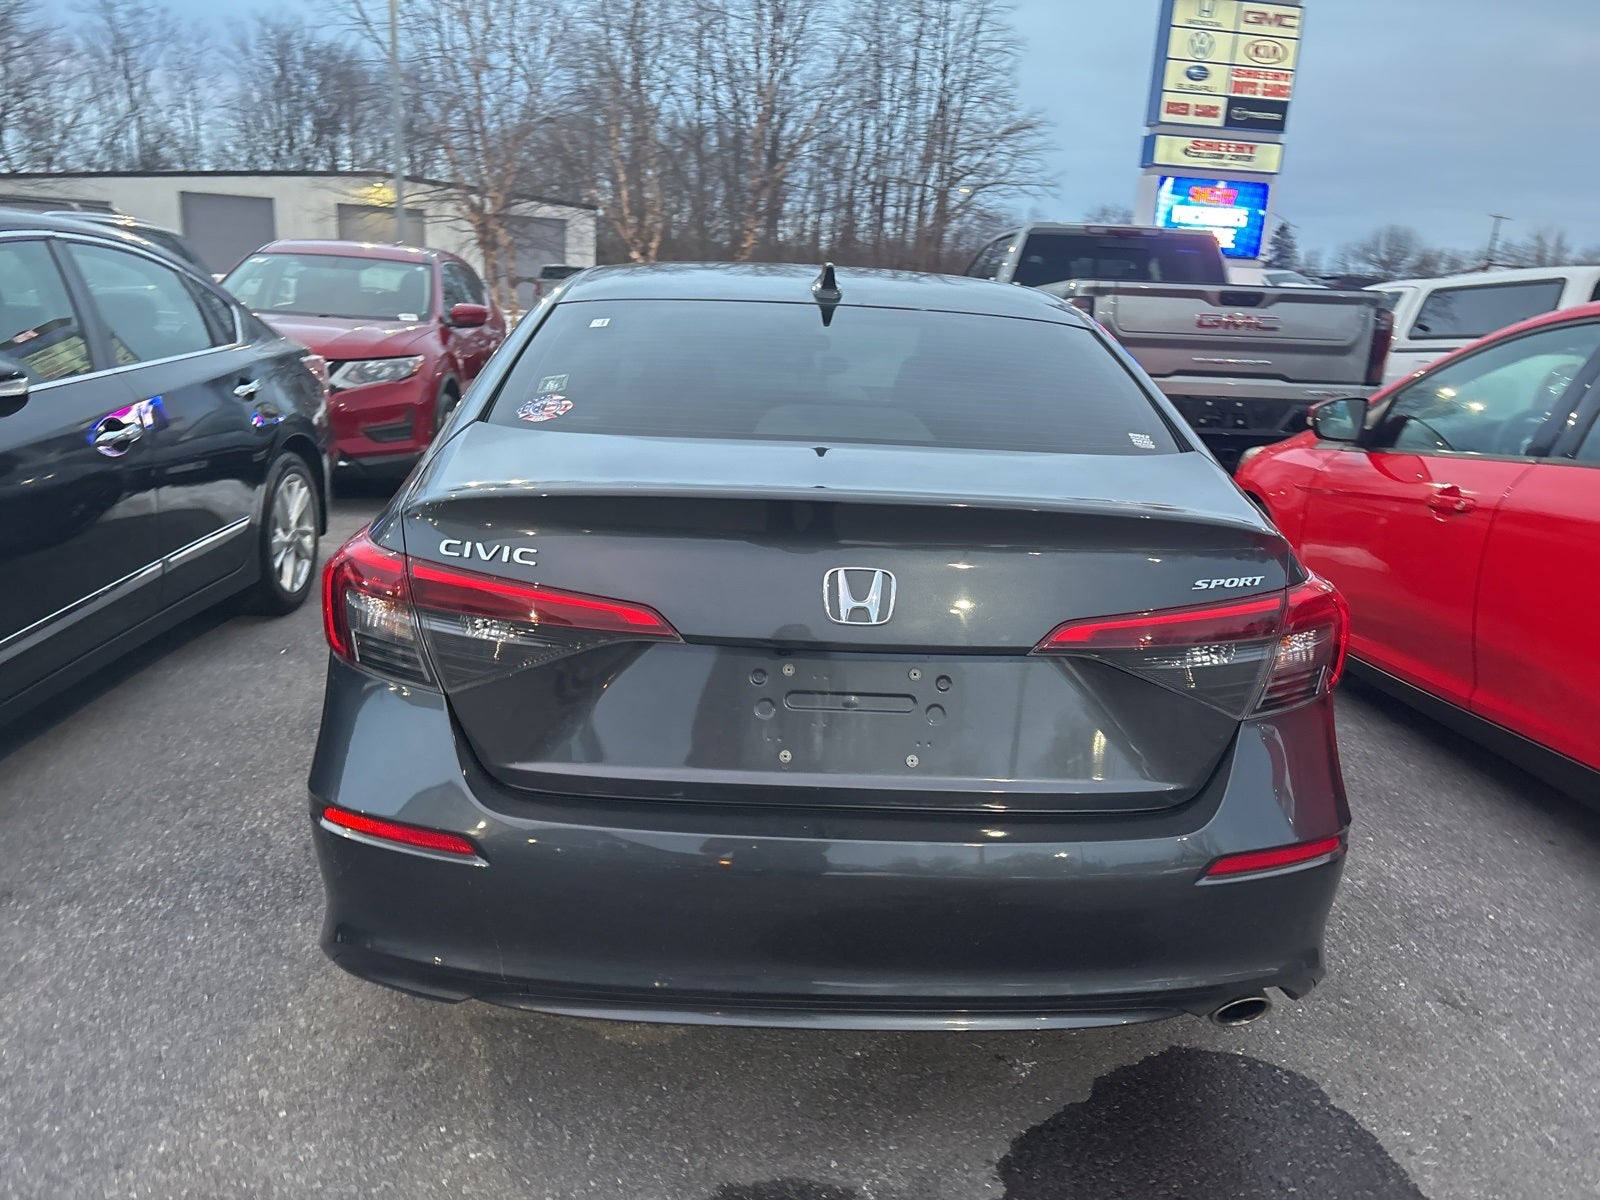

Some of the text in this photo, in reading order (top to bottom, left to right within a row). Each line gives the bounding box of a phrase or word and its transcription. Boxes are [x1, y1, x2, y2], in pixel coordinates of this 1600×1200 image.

[1244, 10, 1297, 29] GMC
[1174, 82, 1217, 92] SUBARU
[1195, 311, 1281, 332] GMC
[439, 539, 538, 566] CIVIC
[1191, 575, 1265, 590] SPORT
